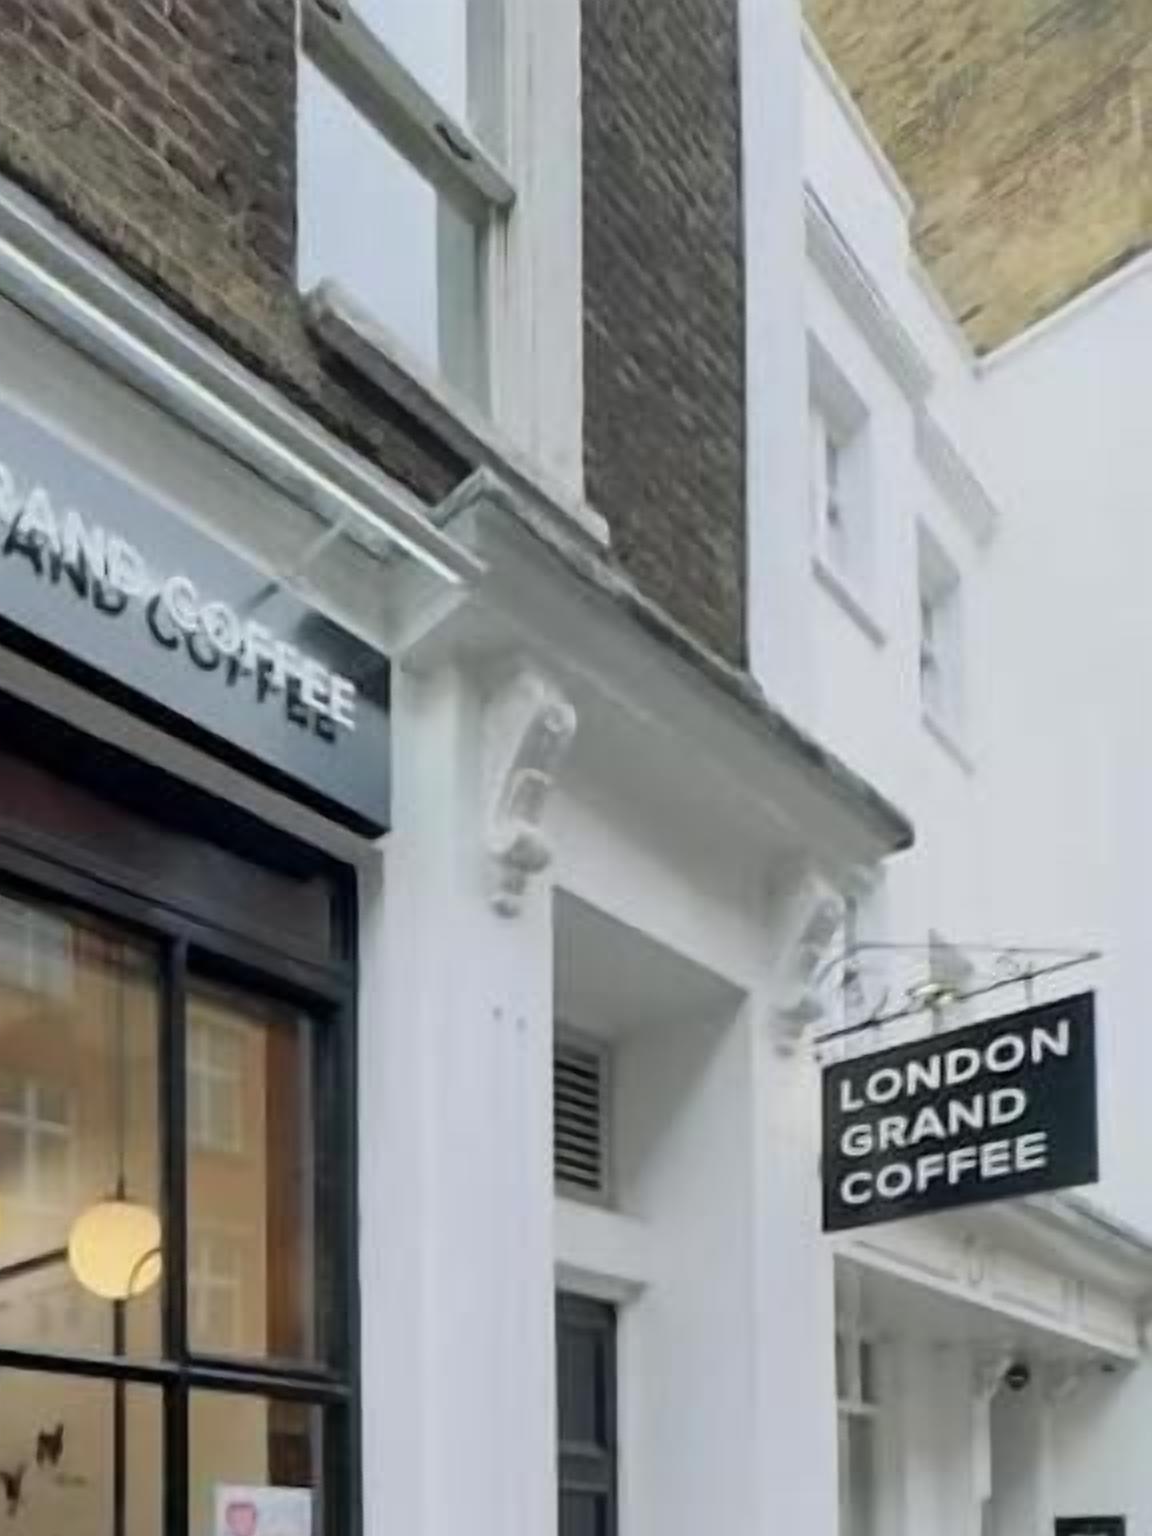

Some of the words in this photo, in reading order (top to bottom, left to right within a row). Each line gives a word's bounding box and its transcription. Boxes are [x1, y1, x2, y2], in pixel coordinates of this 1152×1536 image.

[148, 576, 357, 742] COFFEE
[840, 1021, 1070, 1112] LONDON
[840, 1087, 1026, 1157] GRAND
[840, 1132, 1047, 1205] COFFEE
